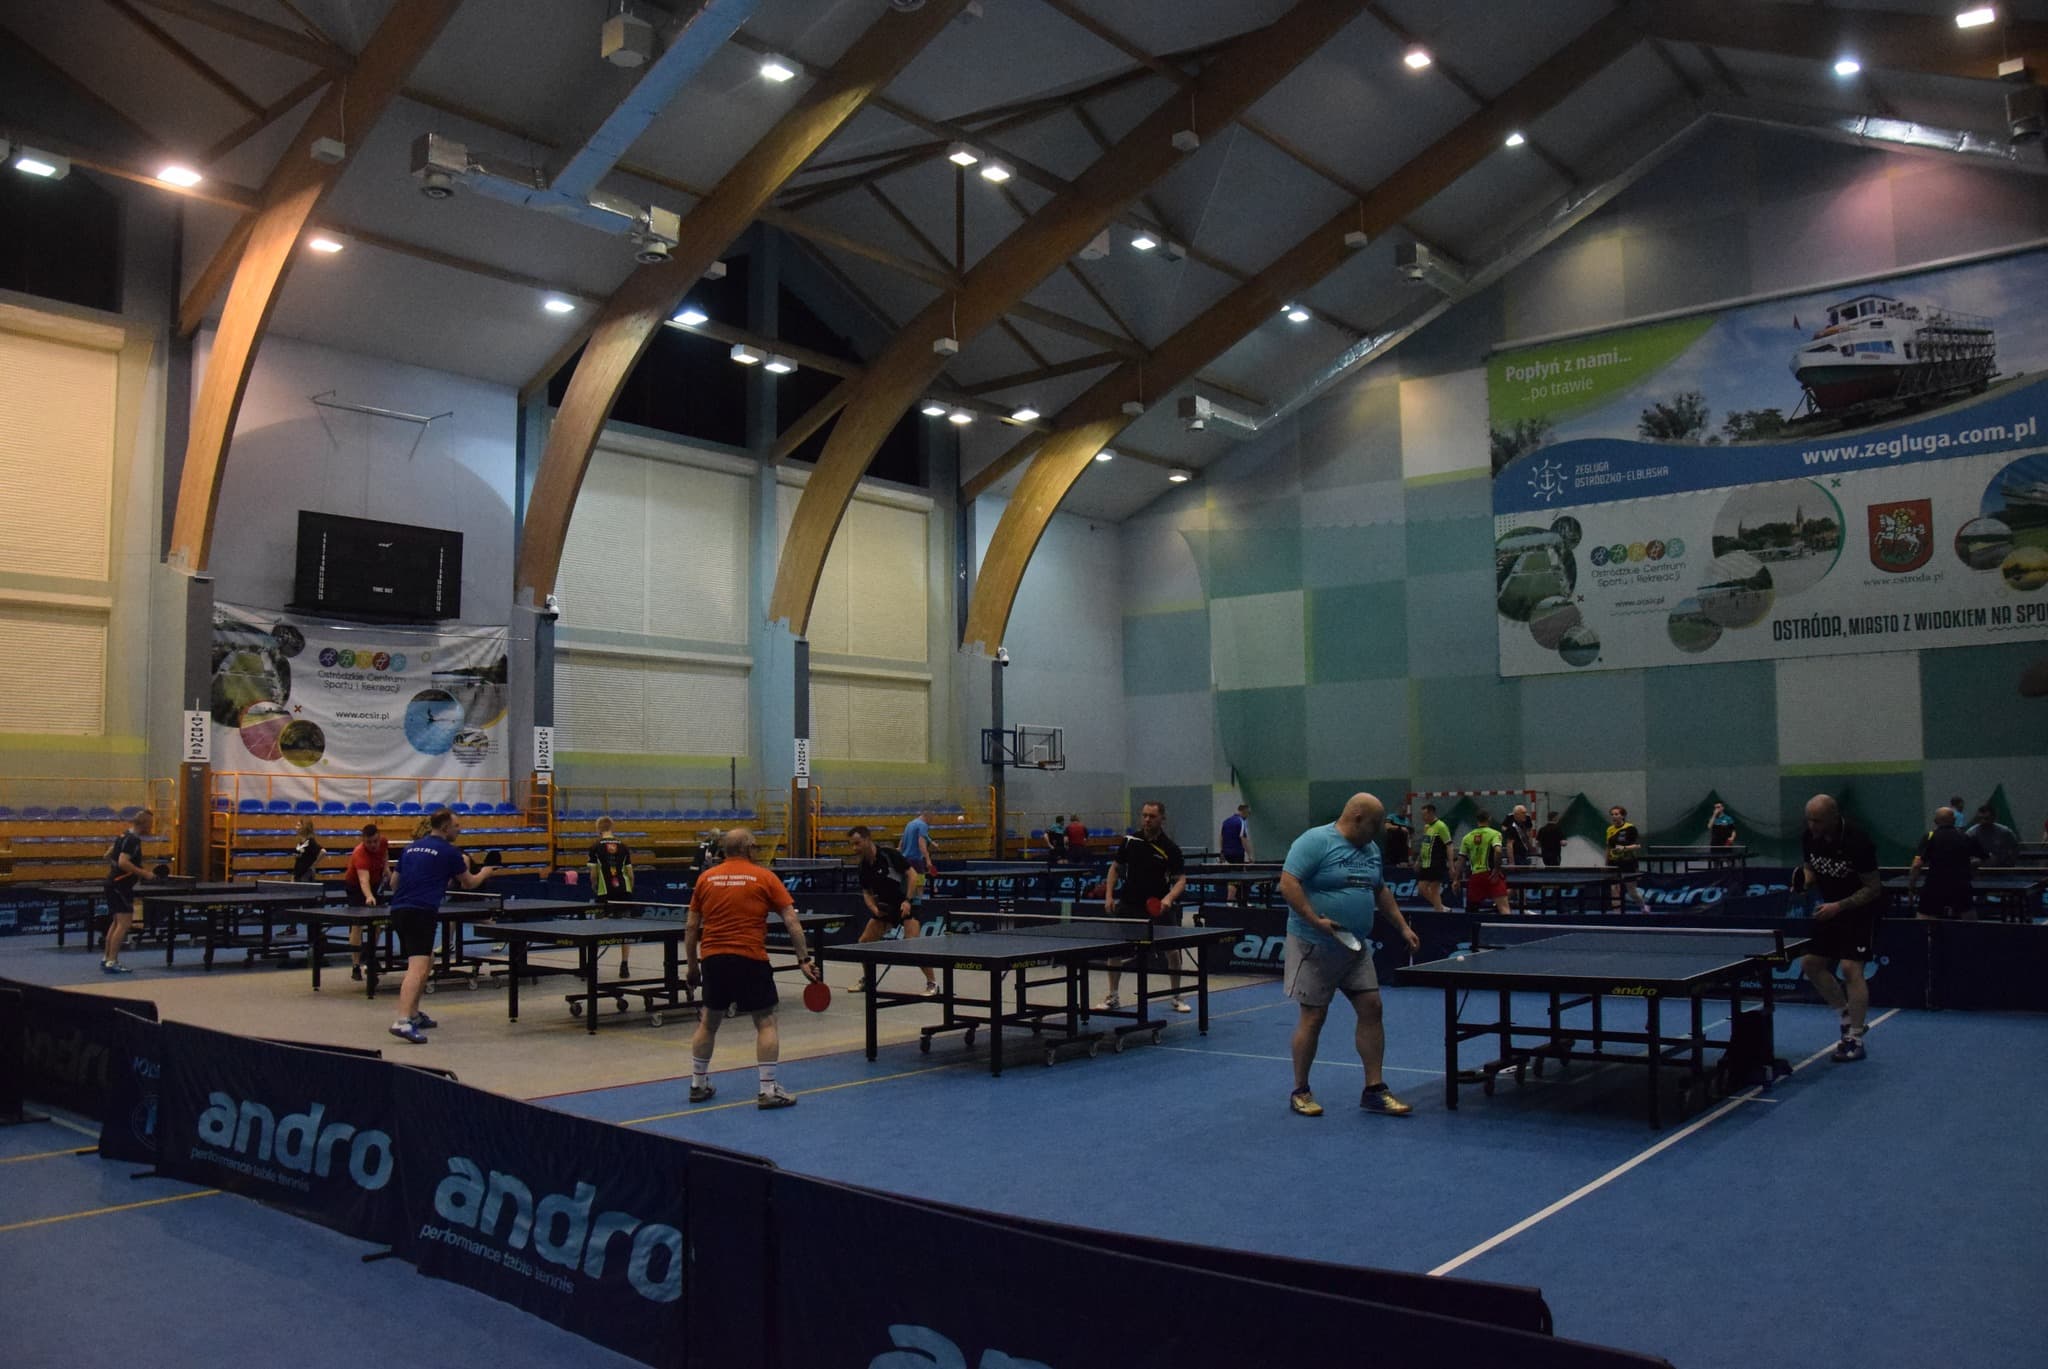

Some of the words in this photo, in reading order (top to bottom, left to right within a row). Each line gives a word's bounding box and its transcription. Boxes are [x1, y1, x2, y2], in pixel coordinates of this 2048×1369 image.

[1505, 357, 1560, 382] Popłyń
[1564, 359, 1572, 372] z
[1575, 347, 1632, 370] nami...
[1551, 376, 1594, 396] trawie
[1802, 416, 2037, 465] www.zegluga.com.pl
[1772, 612, 1848, 641] OSTRÓDA,
[1849, 614, 1899, 636] MIASTO
[1903, 613, 1910, 631] Z
[1914, 607, 1986, 631] WIDOKIEM
[1991, 605, 2012, 625] NA
[336, 711, 390, 721] www.ocsir.pl
[1611, 985, 1659, 996] andro
[198, 1090, 394, 1190] andro
[434, 1156, 683, 1303] andro
[419, 1224, 501, 1262] performance
[503, 1252, 533, 1277] table
[535, 1266, 576, 1295] tennis
